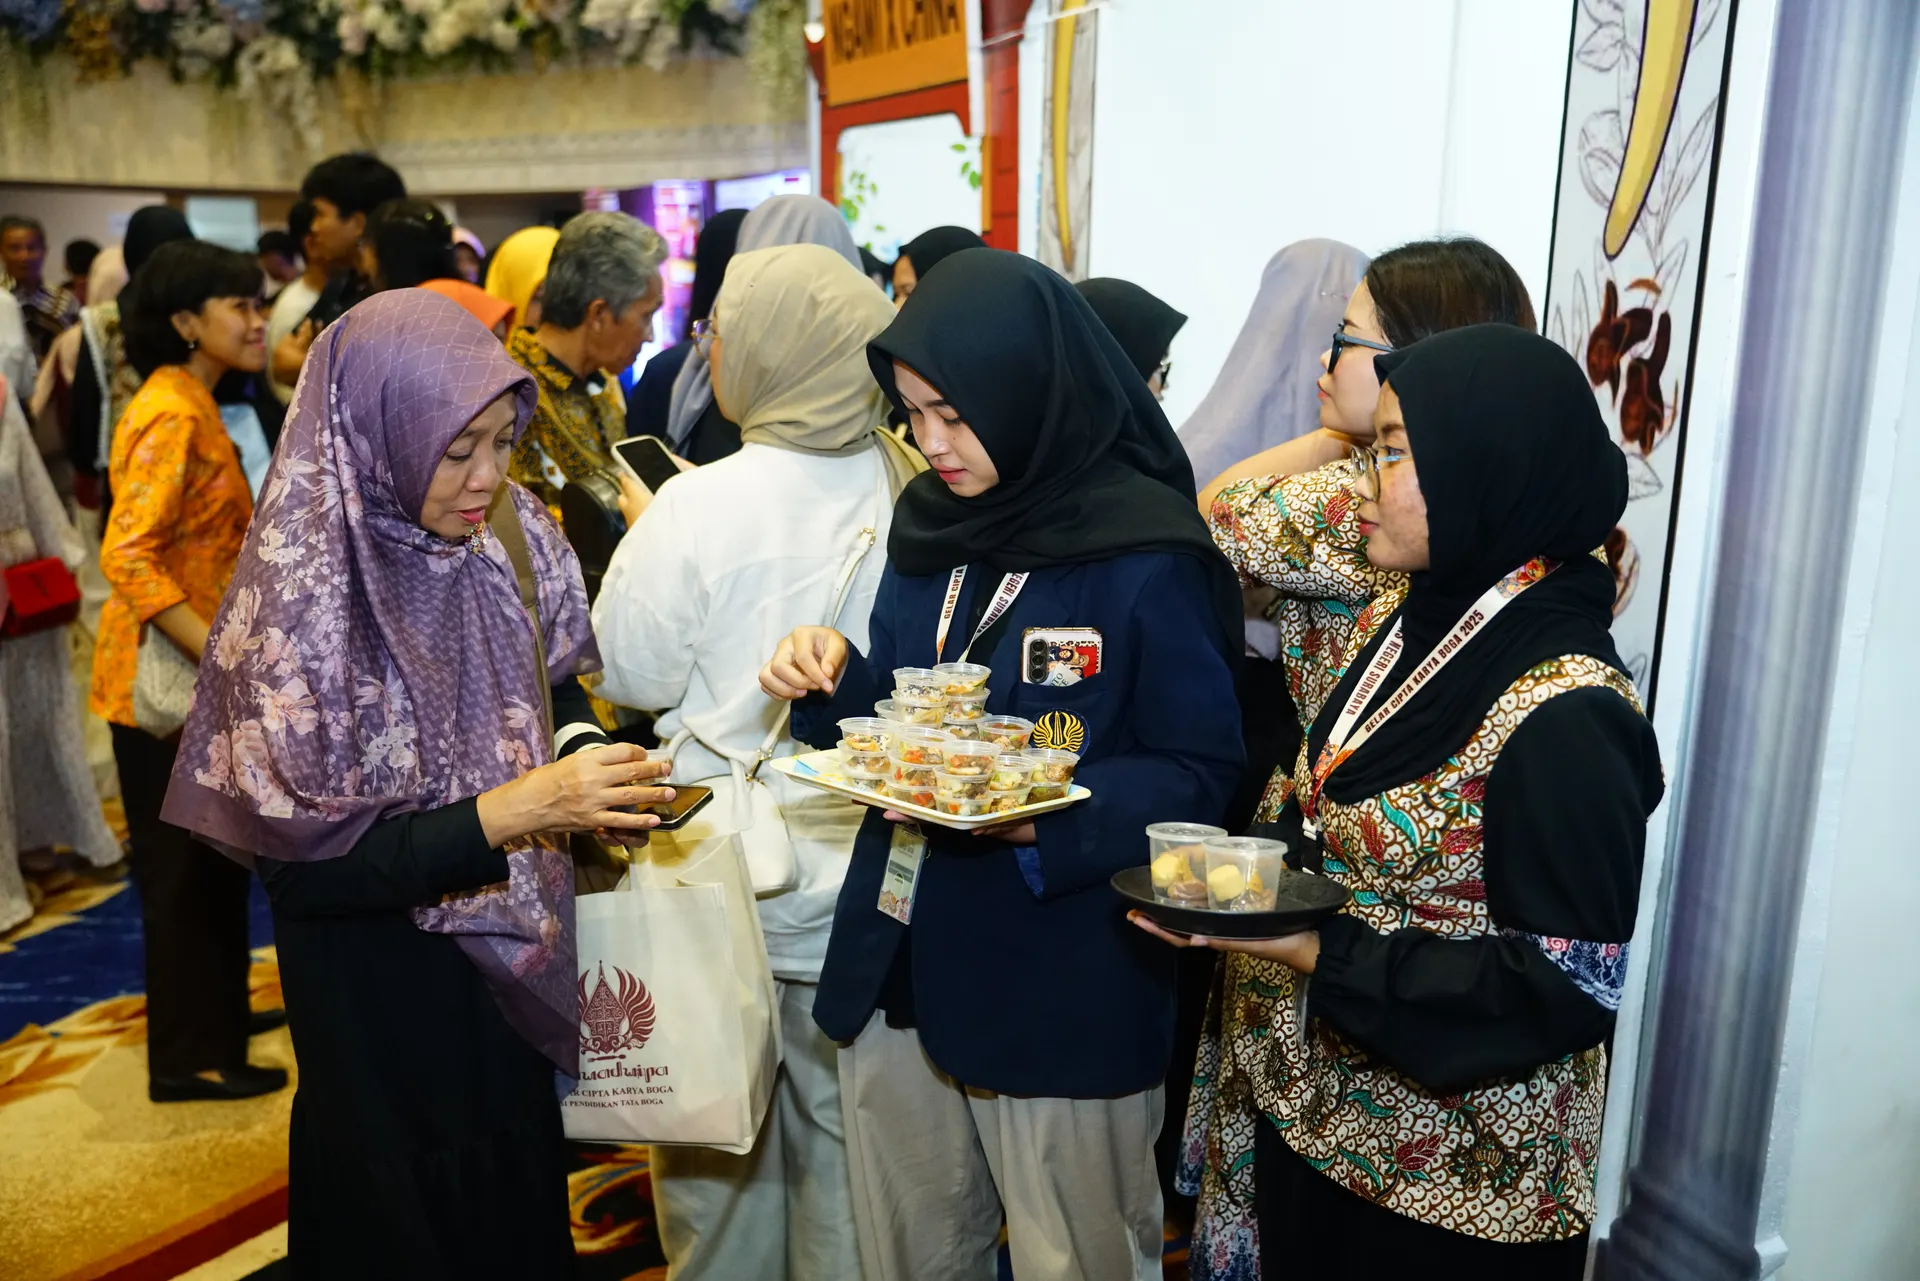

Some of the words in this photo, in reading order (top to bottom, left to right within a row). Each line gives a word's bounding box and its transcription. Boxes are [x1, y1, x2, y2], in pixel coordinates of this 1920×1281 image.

[944, 594, 957, 619] GELAR
[951, 568, 964, 591] CIPTA
[1365, 707, 1391, 733] GELAR
[1390, 684, 1414, 709] CIPTA
[1412, 656, 1440, 685] KARYA
[1437, 633, 1463, 659] BOGA
[1460, 609, 1485, 636] 2025
[1374, 640, 1402, 672] NEGERI
[1346, 671, 1380, 716] SURABAYA
[579, 1061, 669, 1083] wadwipa
[570, 1100, 619, 1108] PENDIDIKAN
[582, 1089, 610, 1098] CIPTA
[612, 1087, 644, 1096] KARYA
[646, 1085, 674, 1094] BOGA
